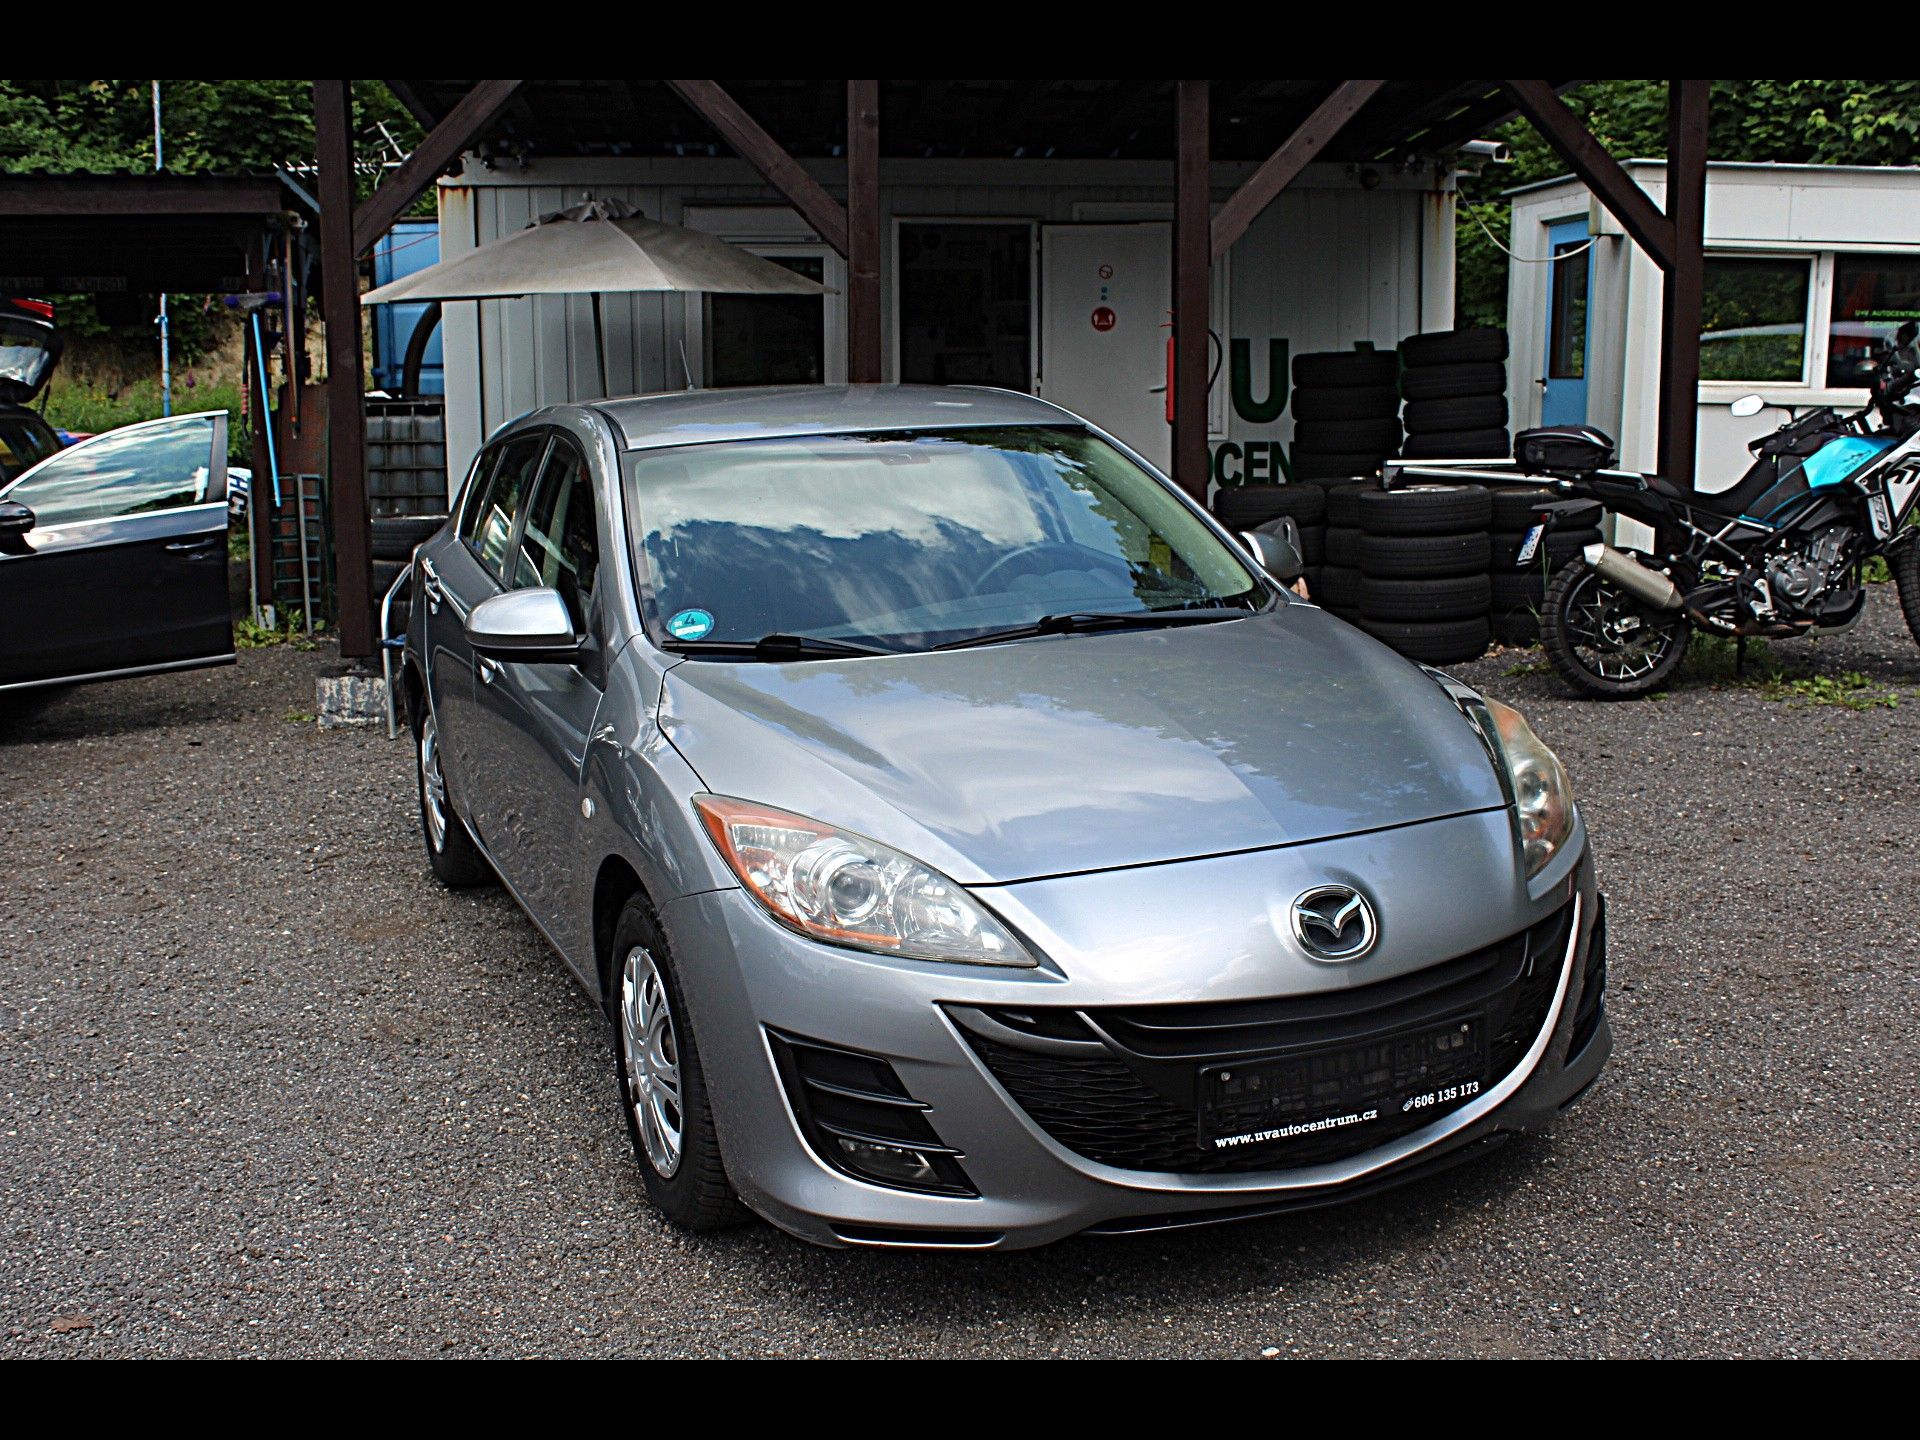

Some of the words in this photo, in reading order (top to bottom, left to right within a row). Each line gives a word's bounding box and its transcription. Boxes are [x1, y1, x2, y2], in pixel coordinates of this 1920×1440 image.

[684, 613, 697, 625] 4
[1414, 1092, 1435, 1109] 606
[1437, 1086, 1457, 1103] 135
[1460, 1081, 1479, 1097] 173
[1214, 1108, 1378, 1148] www.uvautocentrum.cz
